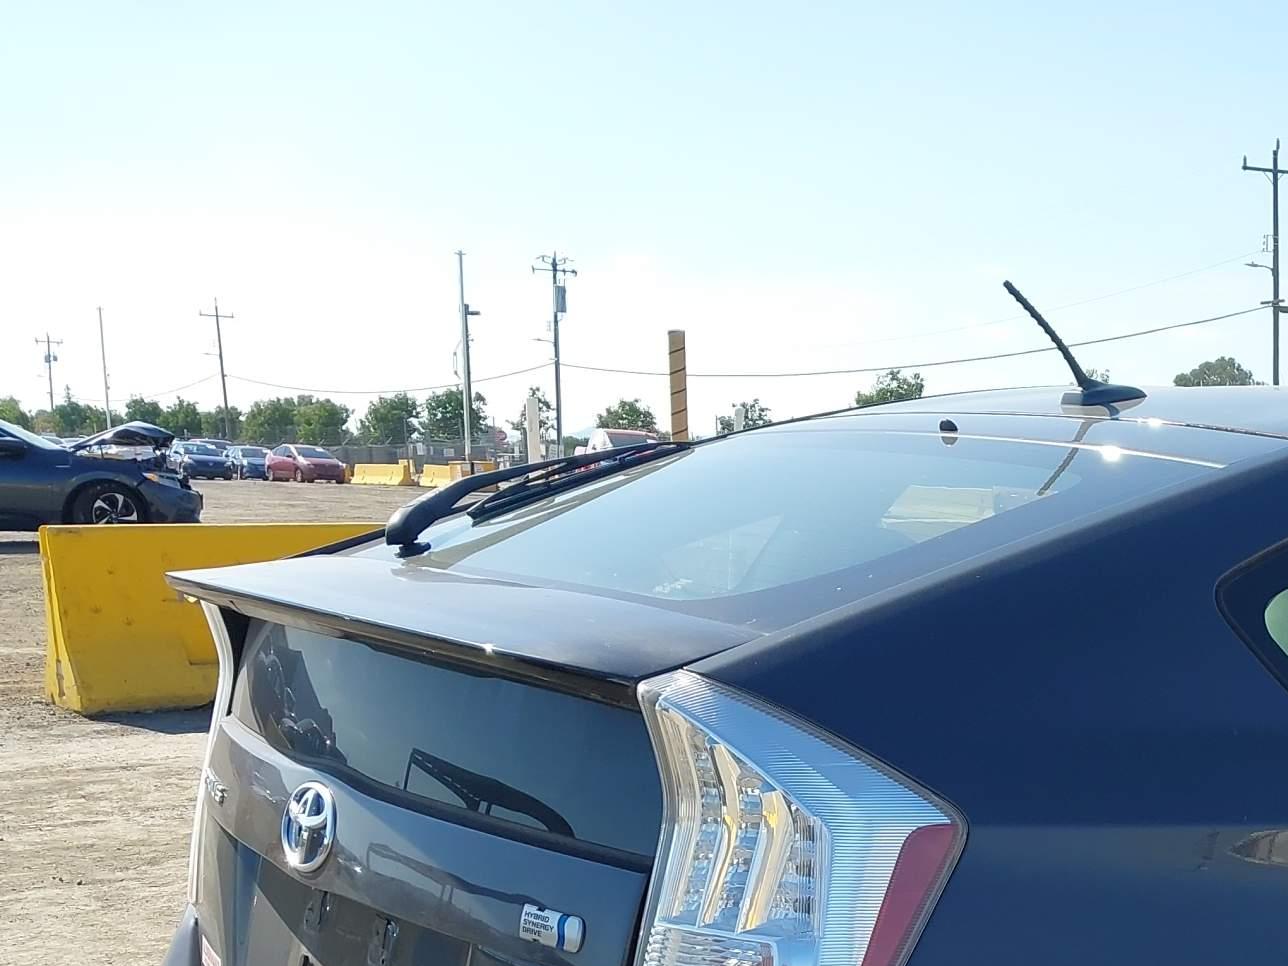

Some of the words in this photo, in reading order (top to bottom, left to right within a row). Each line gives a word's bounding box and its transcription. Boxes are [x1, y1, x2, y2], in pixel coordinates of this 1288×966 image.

[524, 910, 550, 924] HYBRID
[521, 926, 543, 937] DRIVE
[522, 918, 554, 933] SYNERGY
